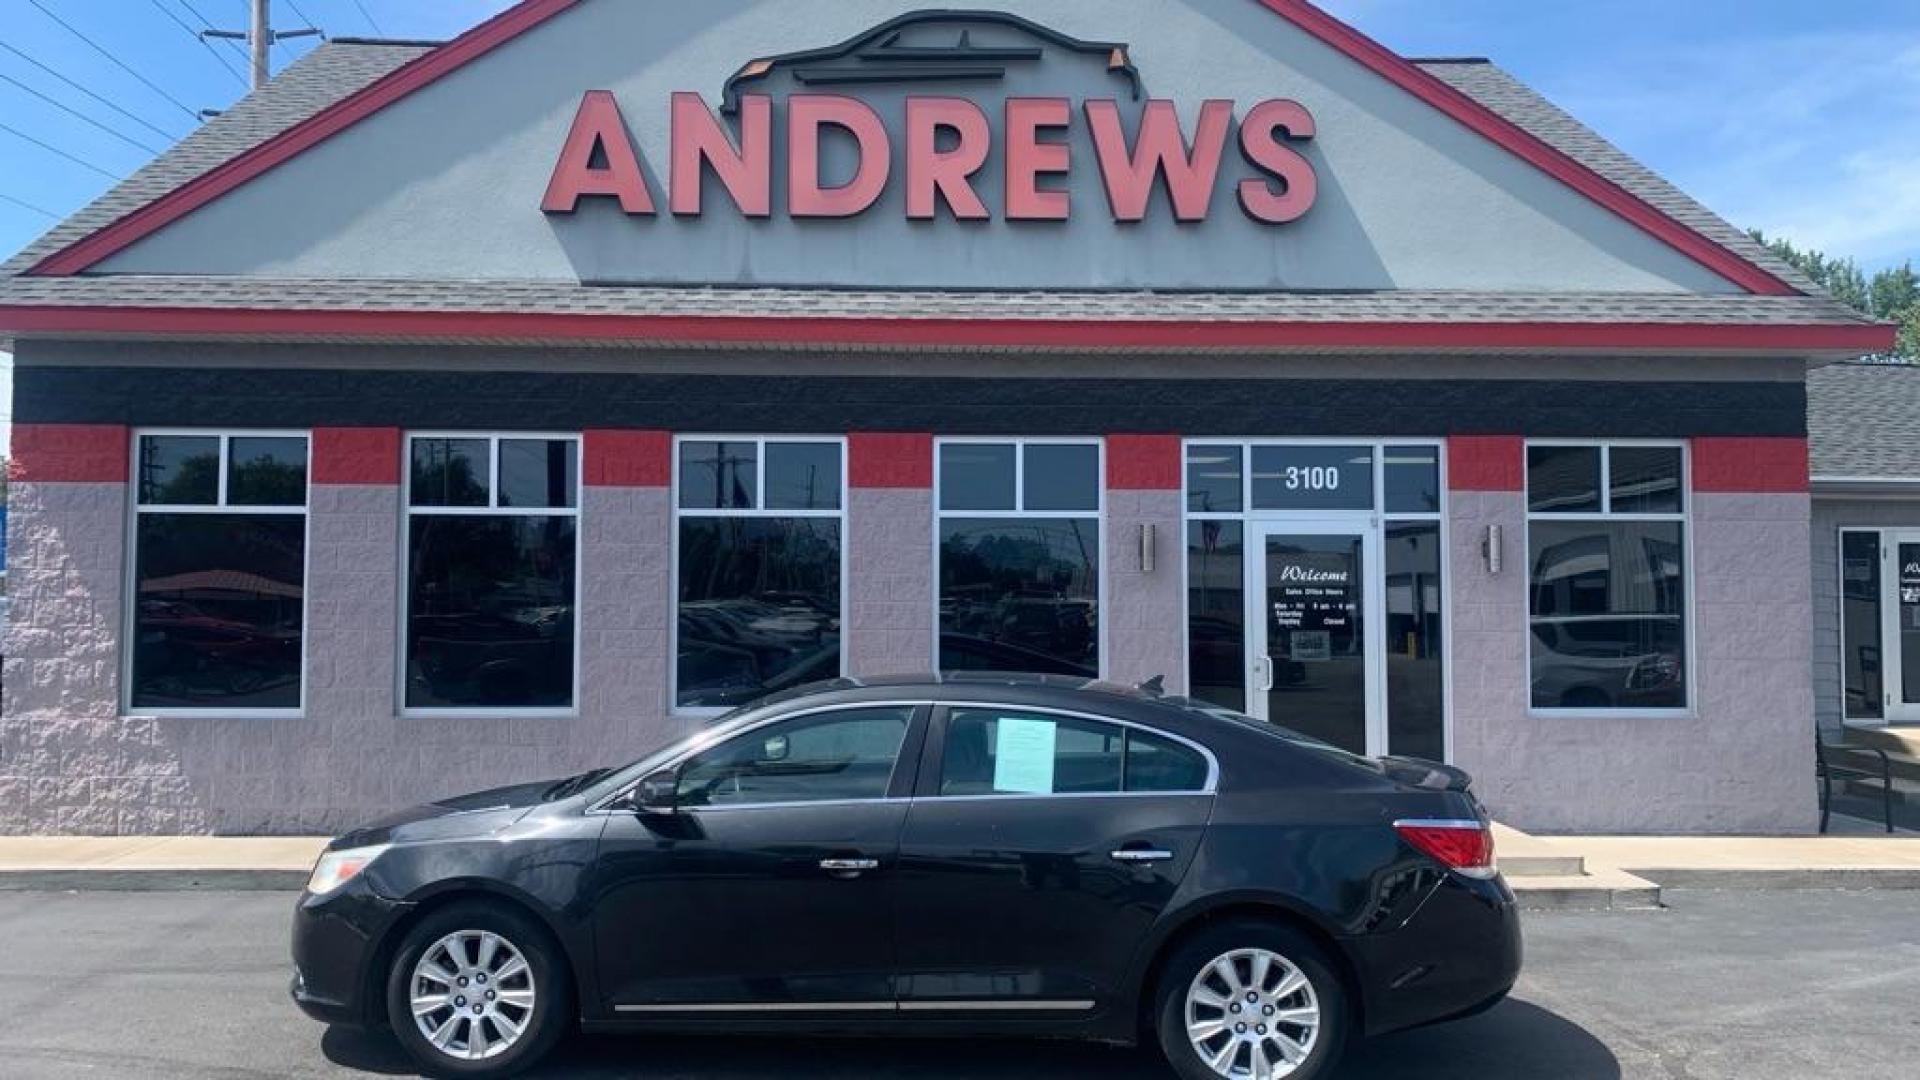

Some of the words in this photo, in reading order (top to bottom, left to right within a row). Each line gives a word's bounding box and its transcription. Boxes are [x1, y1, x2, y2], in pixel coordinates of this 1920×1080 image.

[540, 90, 1318, 225] ANDREWS
[1285, 466, 1338, 490] 3100
[1281, 565, 1347, 581] Welcome
